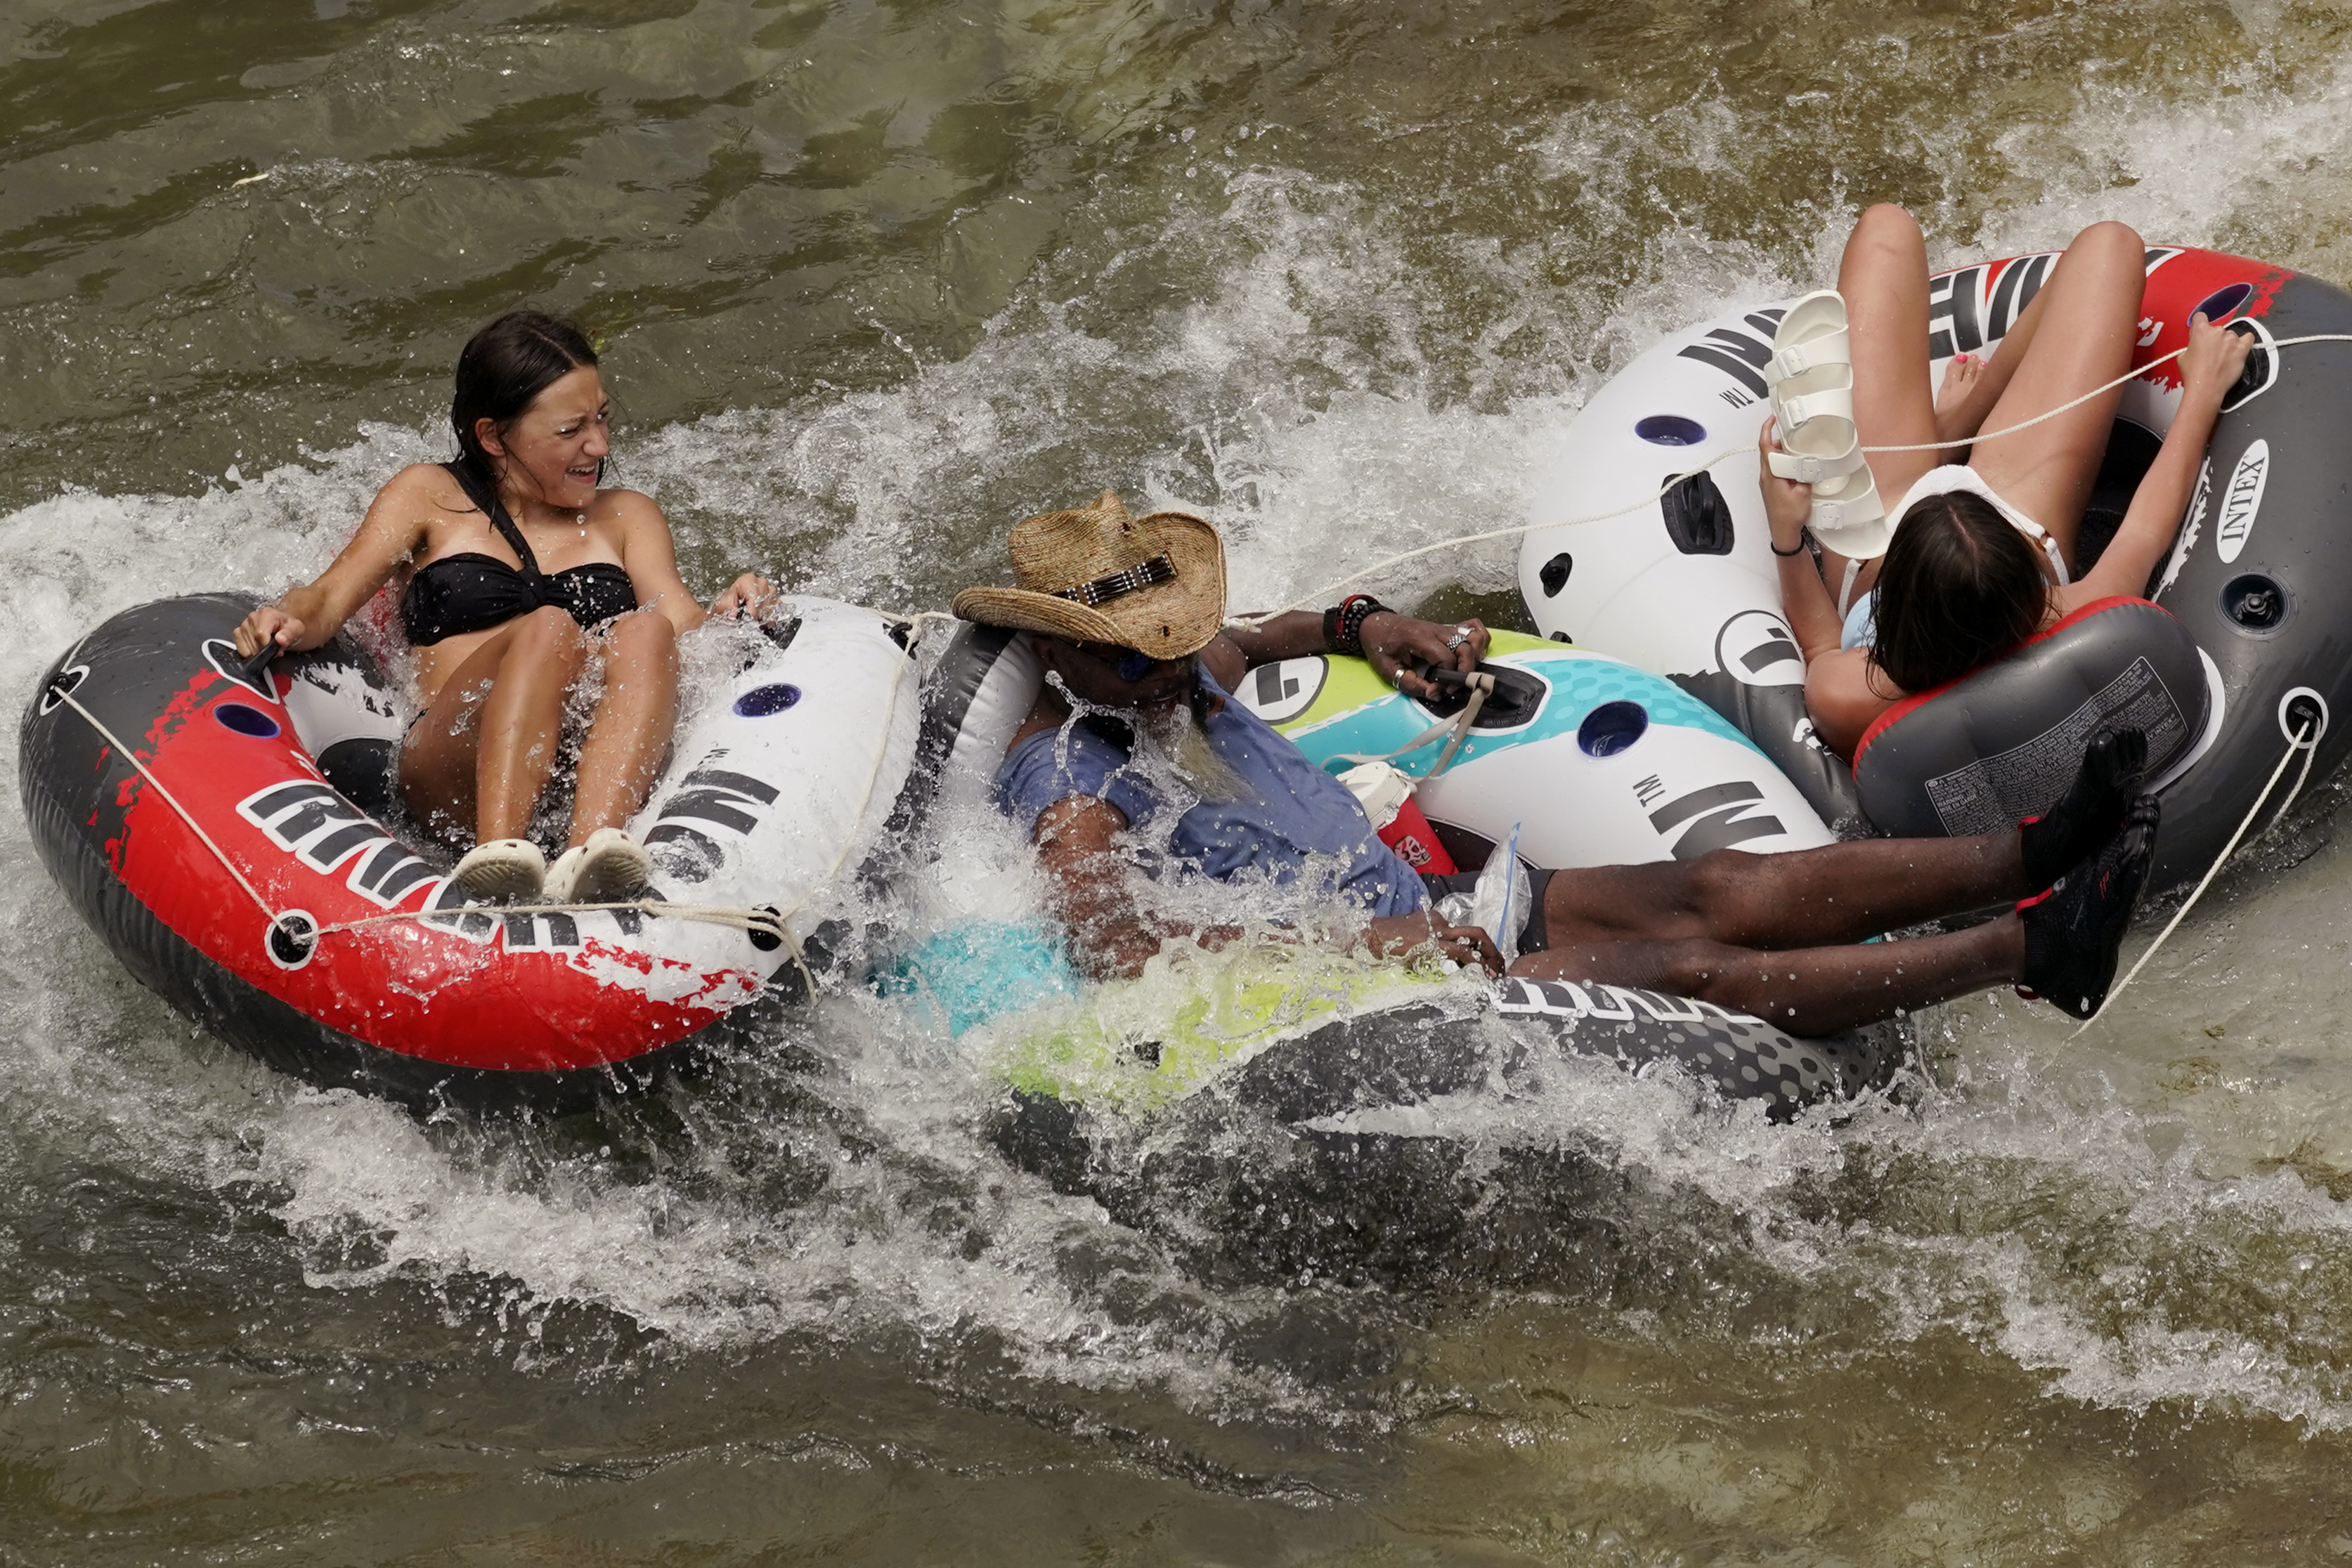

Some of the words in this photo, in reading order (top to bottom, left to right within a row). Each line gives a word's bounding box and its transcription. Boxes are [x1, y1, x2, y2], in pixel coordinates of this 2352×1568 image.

[1719, 387, 1755, 409] TM
[2220, 456, 2265, 542] INTEX
[1634, 773, 1666, 809] TM
